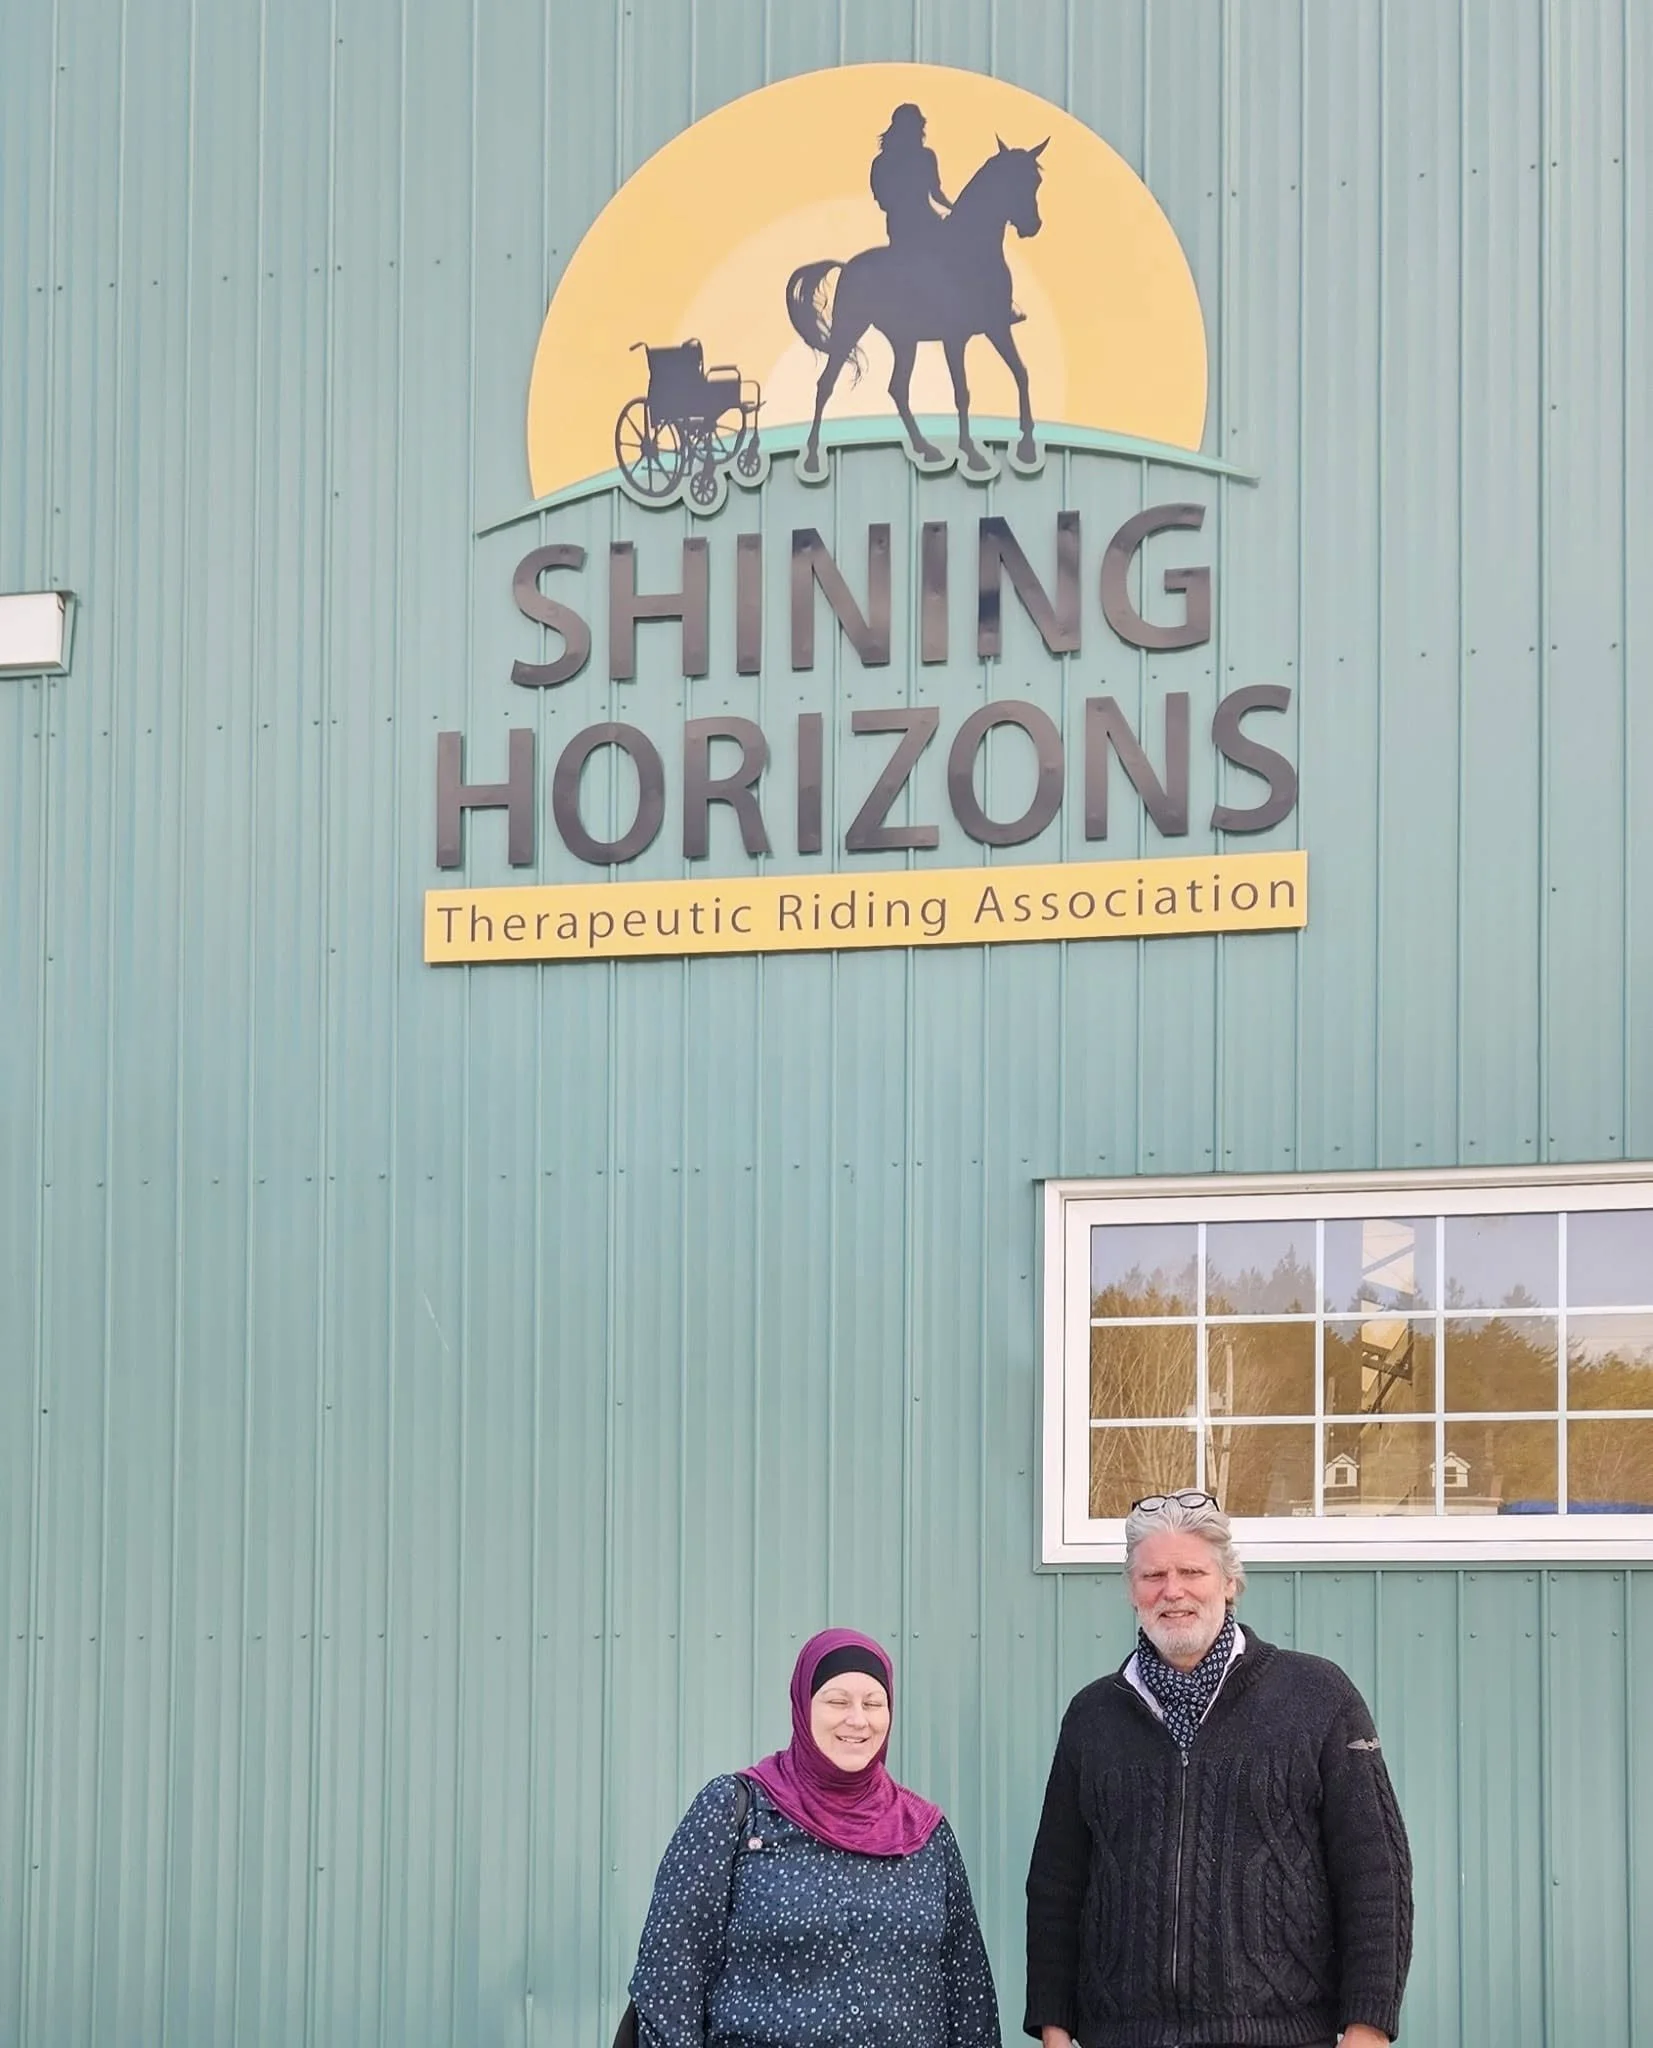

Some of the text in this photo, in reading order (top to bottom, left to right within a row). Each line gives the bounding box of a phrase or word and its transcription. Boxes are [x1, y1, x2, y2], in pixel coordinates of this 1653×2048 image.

[511, 503, 1211, 687] SHINING
[436, 684, 1299, 868] HORIZONS
[437, 873, 1295, 949] Therapeutic Riding Association
